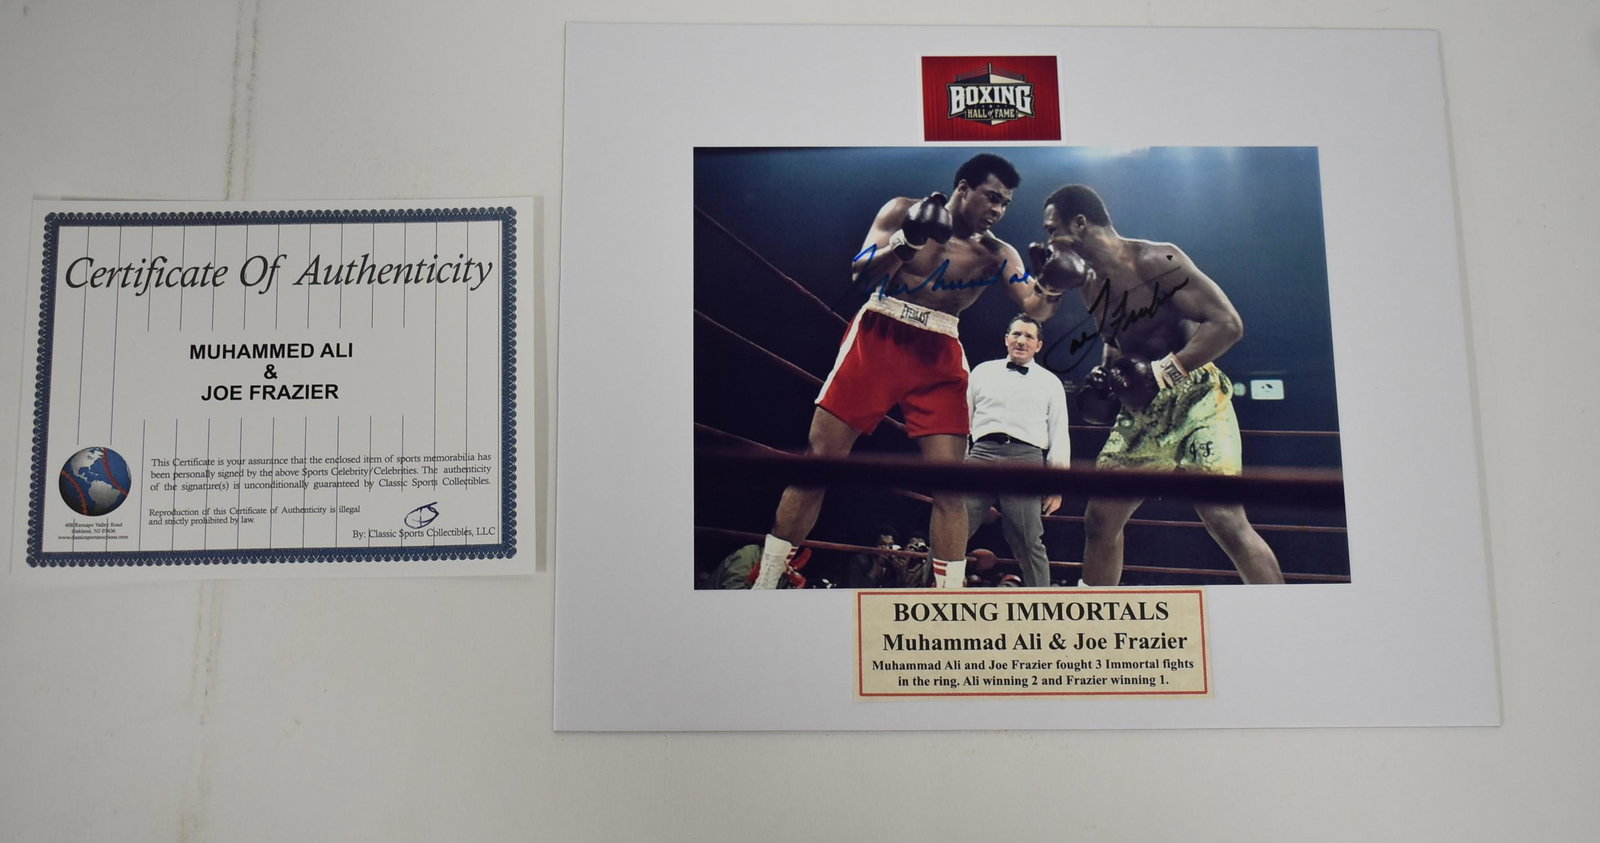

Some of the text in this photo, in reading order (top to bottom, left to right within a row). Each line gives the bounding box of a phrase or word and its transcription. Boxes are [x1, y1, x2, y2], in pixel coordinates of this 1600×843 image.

[949, 86, 1031, 114] BOXING
[968, 109, 987, 118] HALL
[995, 109, 1014, 118] FAME
[65, 254, 493, 296] Certificate Of Authenticity
[190, 343, 353, 360] MUHAMMED ALI
[264, 364, 278, 379] &
[201, 384, 338, 401] JOE FRAZIER
[173, 458, 215, 466] Certificate
[227, 459, 244, 467] your
[325, 455, 361, 463] enclosed
[364, 455, 382, 463] item
[385, 455, 394, 463] of
[397, 455, 421, 464] sports
[424, 453, 475, 462] memorabilia
[478, 453, 491, 461] has
[151, 471, 170, 479] been
[174, 470, 214, 480] personally
[218, 470, 244, 479] signed
[247, 469, 257, 478] by
[274, 467, 300, 476] above
[302, 468, 328, 478] Sports
[331, 466, 419, 476] Celebrity/Celebrities.
[422, 466, 438, 474] The
[444, 465, 491, 474] authenticity
[150, 482, 159, 491] of
[164, 482, 177, 490] the
[182, 481, 229, 492] signature(s)
[244, 480, 309, 489] unconditionally
[313, 479, 359, 489] guaranteed
[364, 479, 374, 489] by
[379, 478, 408, 487] Classic
[412, 478, 437, 487] Sports
[442, 477, 490, 486] Collectibles.
[149, 508, 199, 517] Reproduction
[202, 508, 210, 516] of
[230, 507, 267, 515] Certificate
[270, 506, 278, 514] of
[282, 506, 326, 514] Authenticity
[339, 505, 360, 514] illegal
[165, 517, 188, 526] strictly
[190, 516, 228, 526] prohibited
[230, 516, 238, 525] by
[353, 527, 495, 539] By: Classic Sports Collectibles, LLC
[893, 602, 1169, 622] BOXING IMMORTALS
[883, 632, 1187, 651] Muhammad Ali & Joe Frazier
[872, 658, 1194, 673] Muhammad Ali and Joe Frazier fought 3 Immortal fights
[898, 674, 1169, 689] in the ring. Ali winning 2 and Frazier winning 1.
